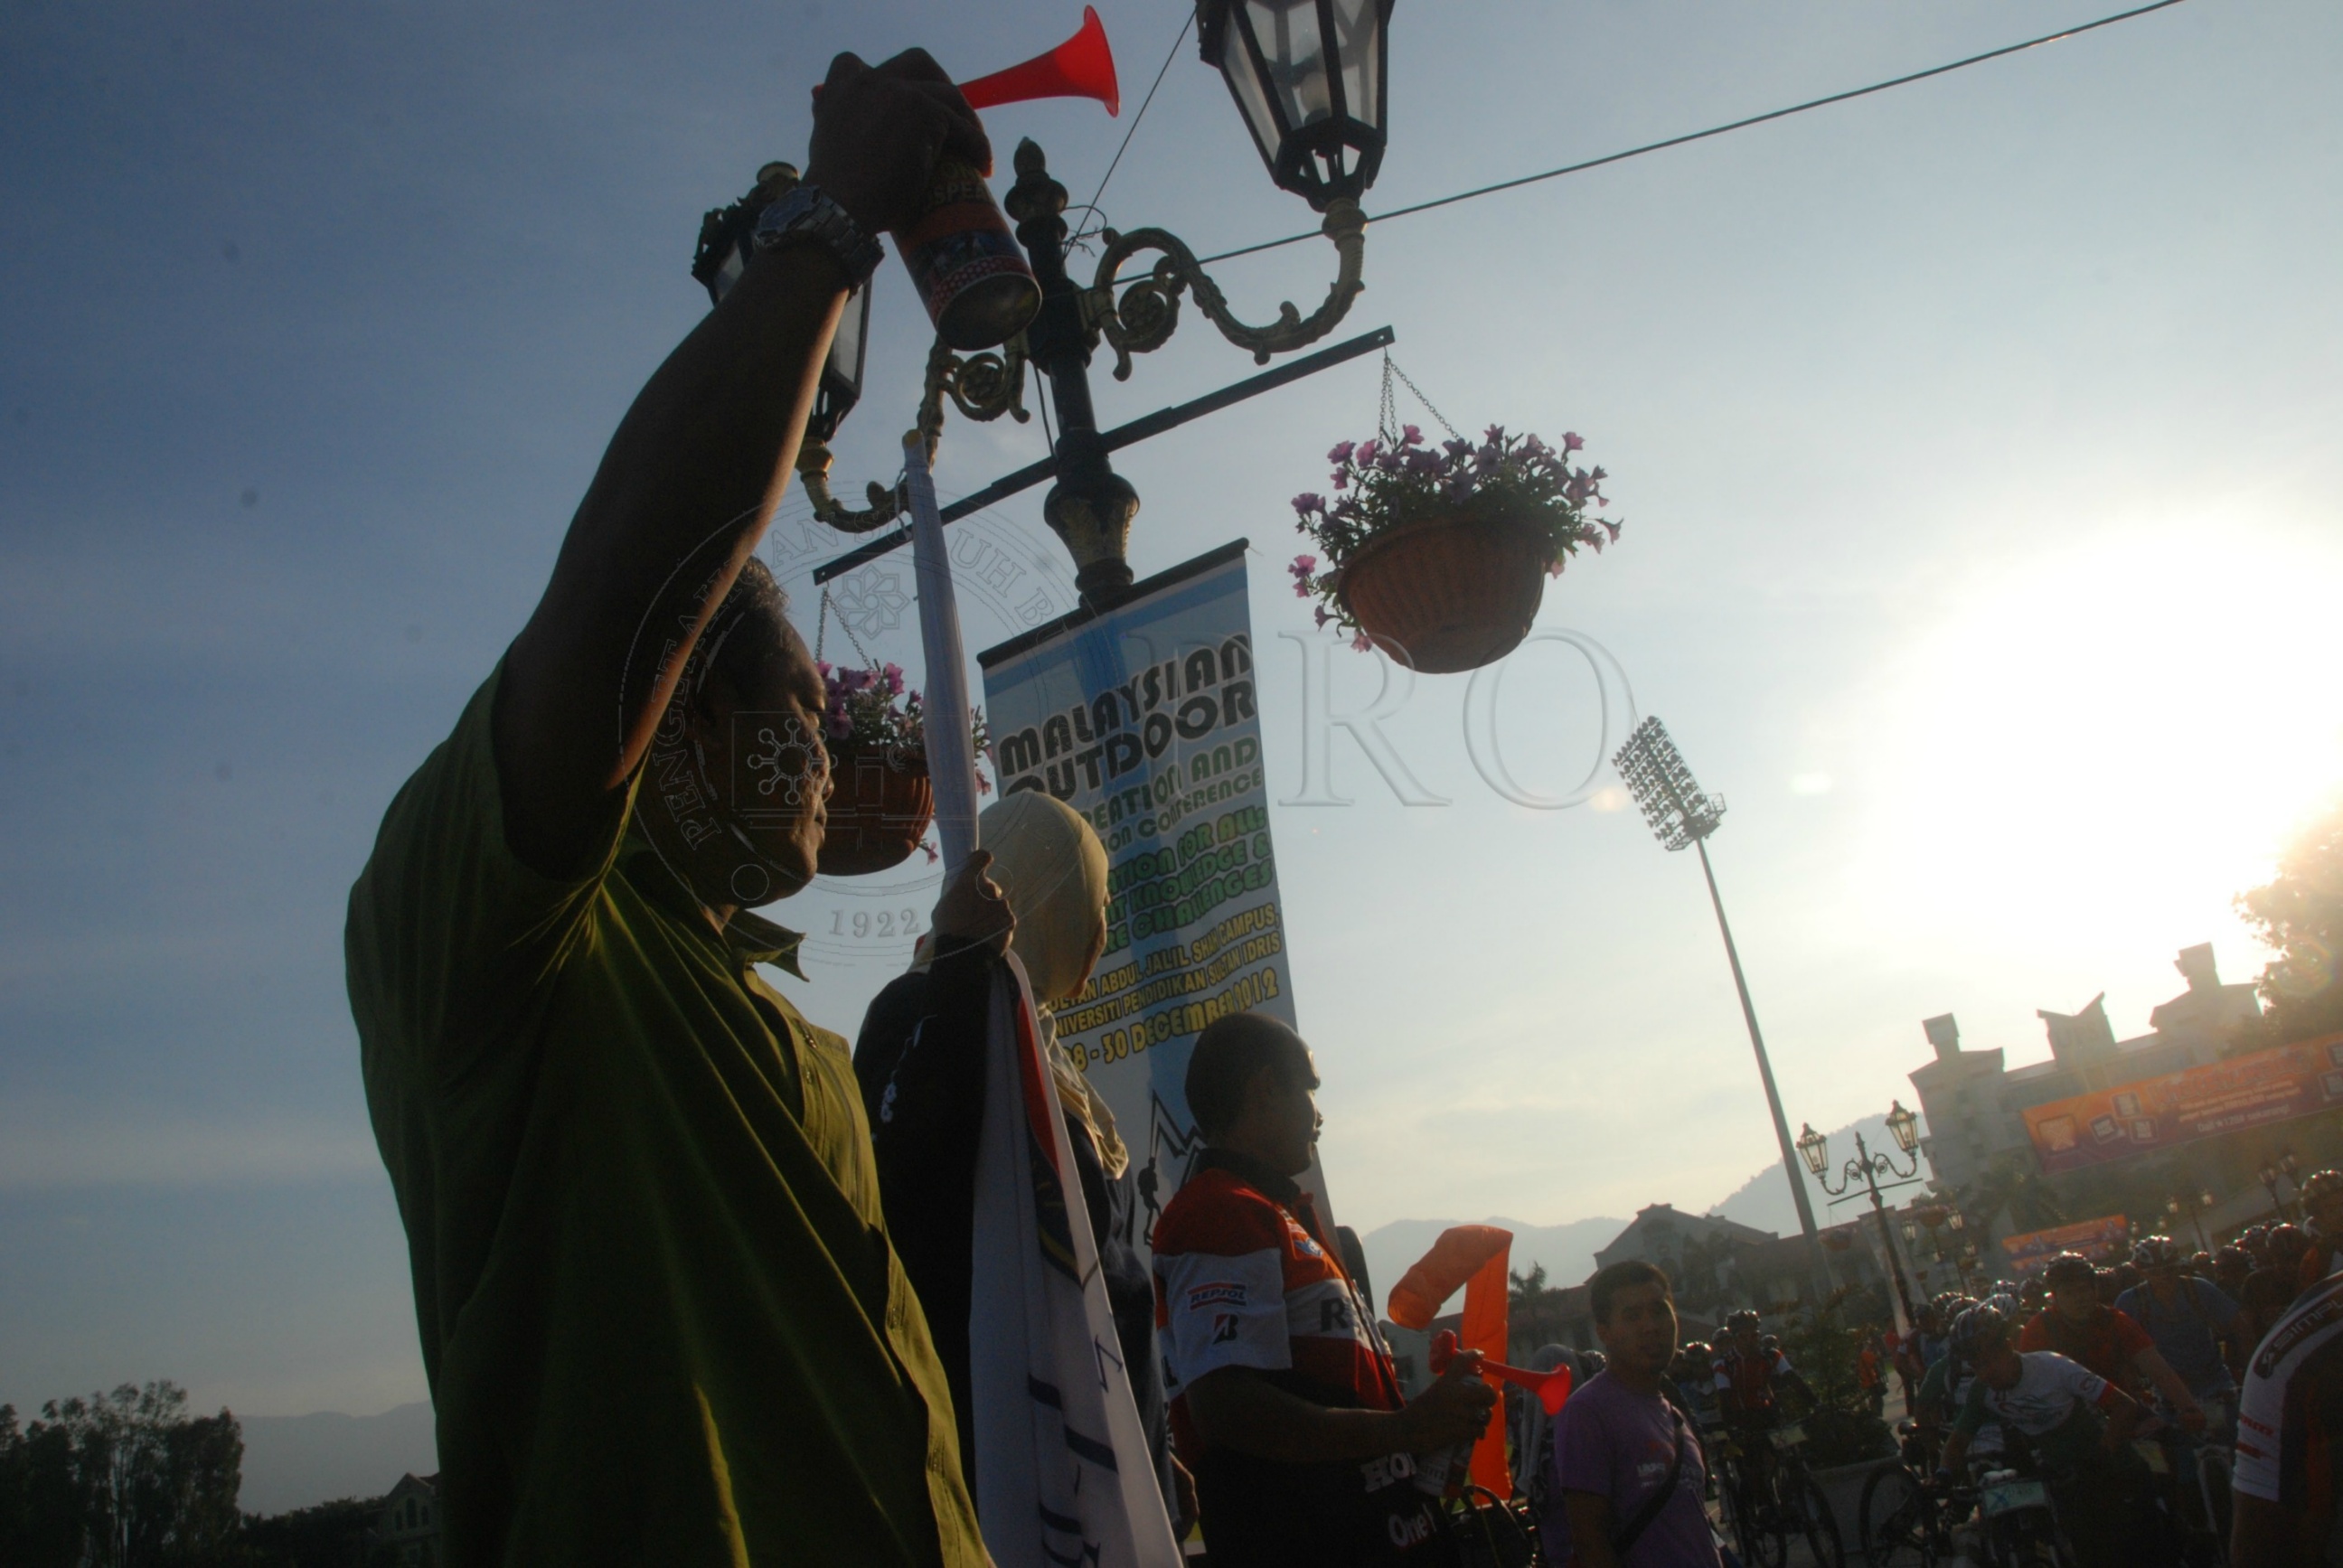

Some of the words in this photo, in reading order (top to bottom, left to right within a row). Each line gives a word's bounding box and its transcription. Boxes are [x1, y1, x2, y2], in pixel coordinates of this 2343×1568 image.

[998, 634, 1252, 777] MALAYSIAN
[1190, 737, 1258, 784] AND
[1137, 766, 1262, 839] CONFERENCE
[1128, 839, 1248, 915] KNOWLEDGE
[1177, 822, 1215, 868] FOR
[1132, 857, 1273, 941] CHALLENGES
[1054, 997, 1123, 1039] NIVERSITI
[1122, 966, 1209, 1017] PENDIDIKAN
[1208, 945, 1243, 986] SULTAN
[1241, 930, 1282, 965] IDRIS
[1099, 960, 1145, 998] ABDUL
[1143, 944, 1191, 978] JALIL
[1129, 988, 1236, 1054] DECEMBER
[1232, 965, 1280, 1014] 2012
[1190, 1289, 1246, 1304] REPSOL
